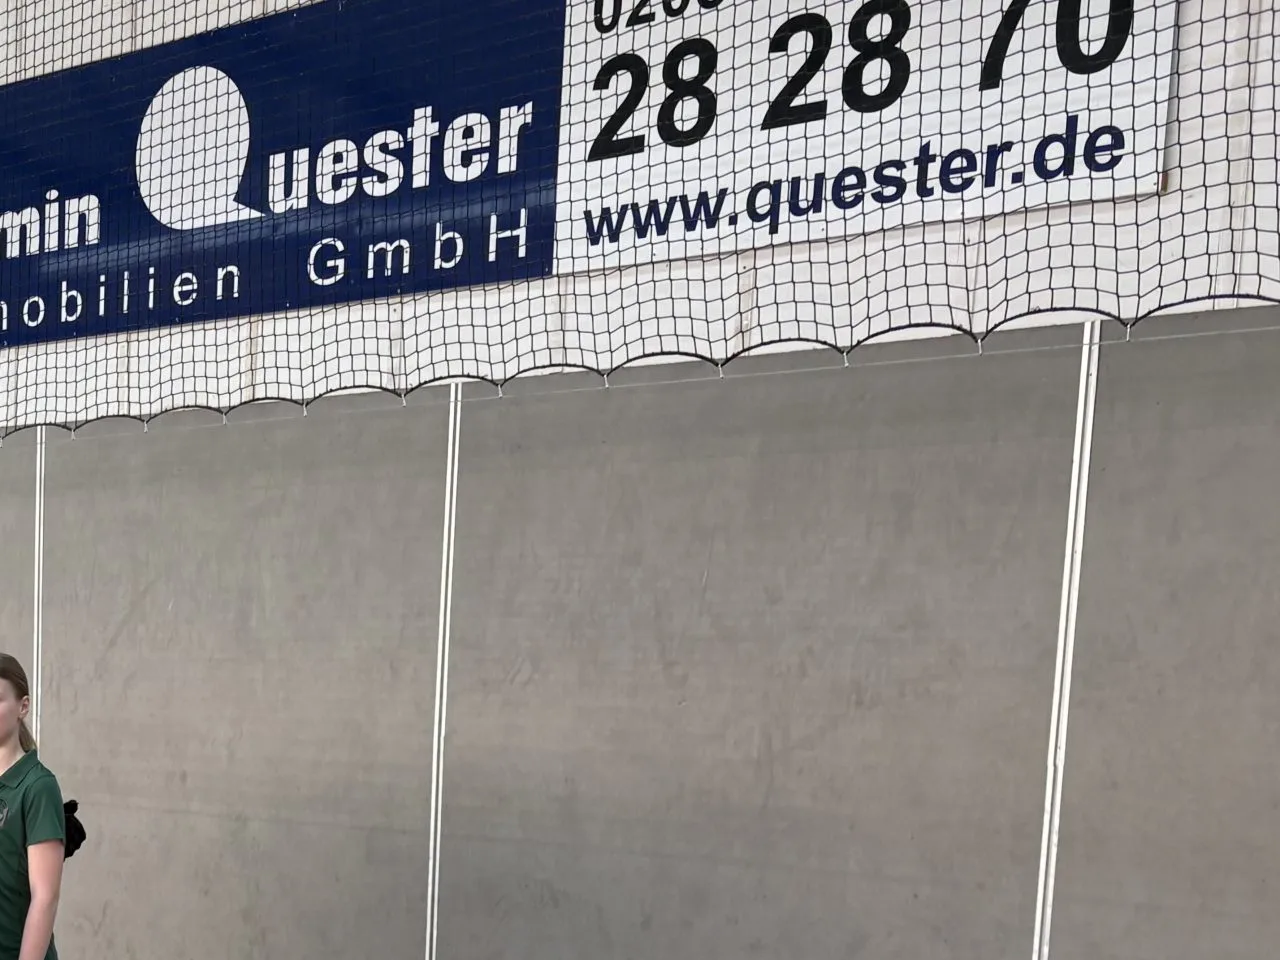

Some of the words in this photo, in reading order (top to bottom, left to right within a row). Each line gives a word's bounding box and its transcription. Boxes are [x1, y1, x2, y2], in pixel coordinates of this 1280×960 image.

[593, 0, 721, 34] 02
[587, 37, 718, 162] 28
[760, 0, 911, 130] 28
[978, 0, 1134, 91] 70
[583, 114, 1126, 247] www.quester.de
[307, 207, 529, 287] GmbH
